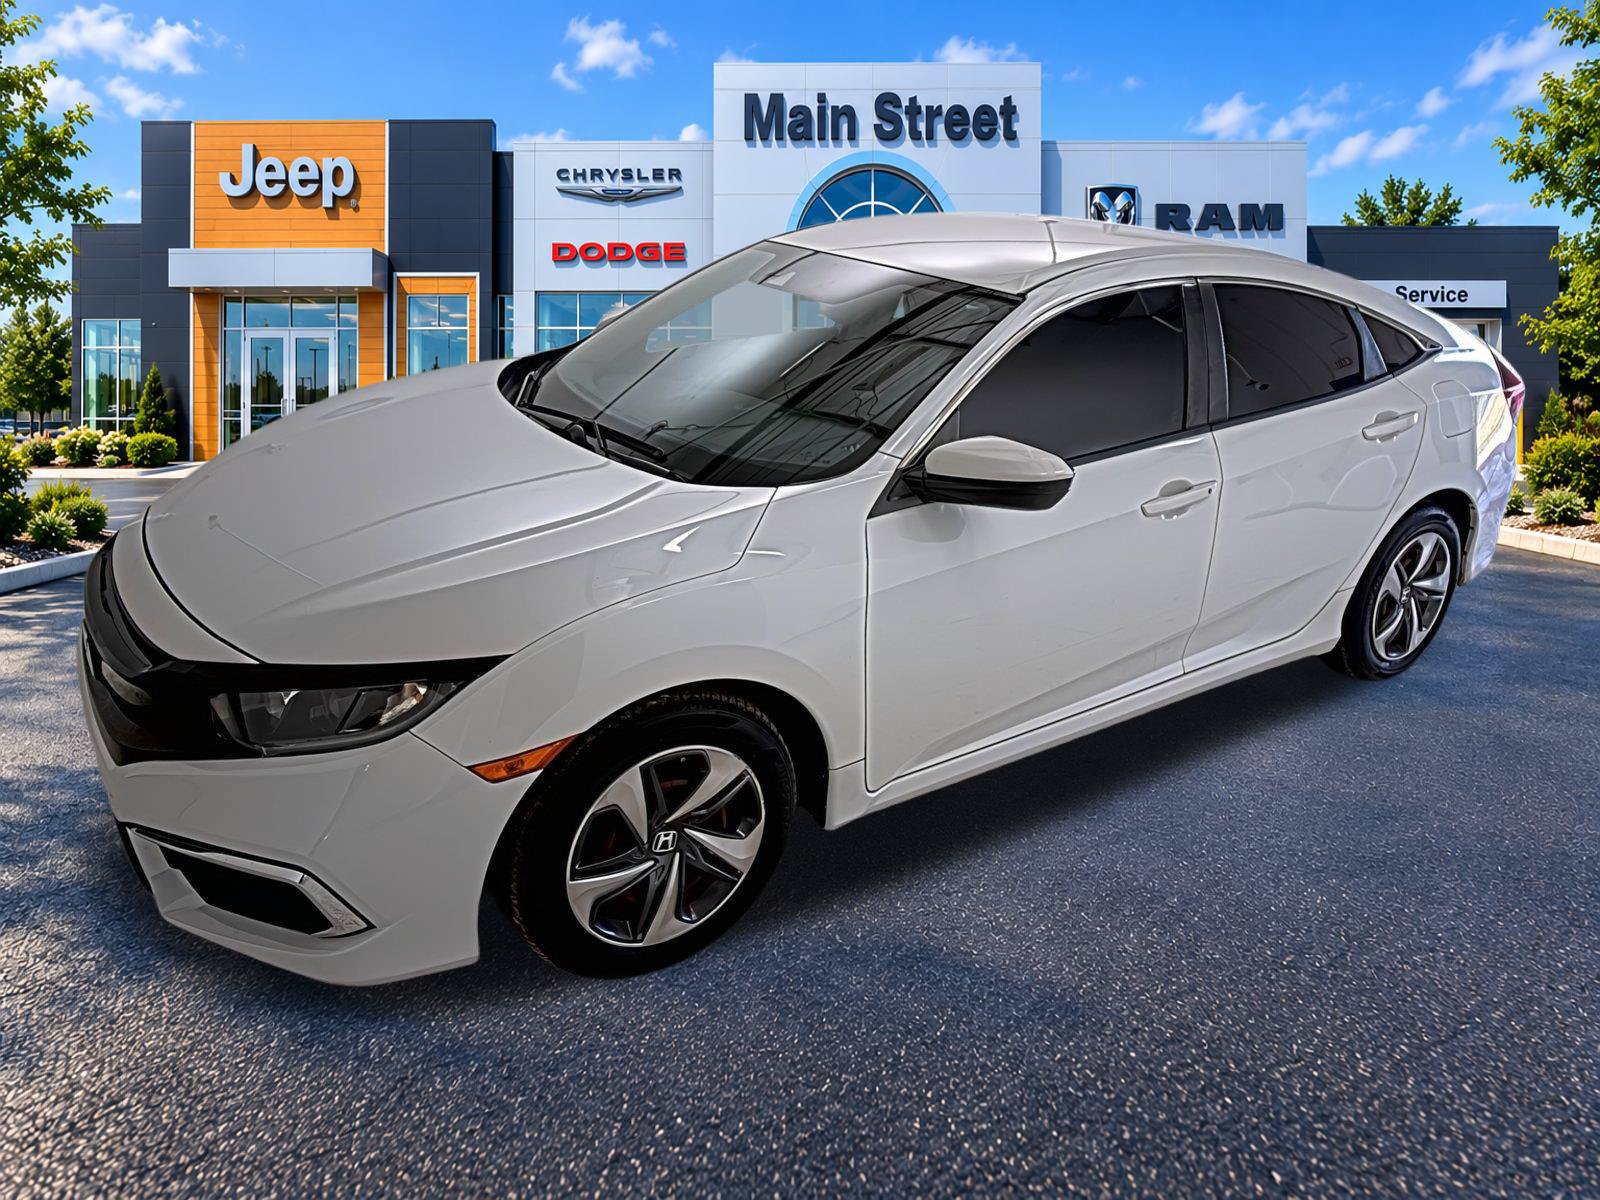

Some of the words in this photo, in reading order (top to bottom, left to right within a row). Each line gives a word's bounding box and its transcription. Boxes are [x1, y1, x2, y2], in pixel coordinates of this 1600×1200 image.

[743, 92, 857, 141] Main
[873, 91, 1018, 141] Street
[219, 143, 356, 209] Jeep
[556, 168, 683, 182] CHRYSLER
[1155, 203, 1285, 232] RAM
[551, 242, 687, 263] DODGE
[1395, 285, 1469, 303] Service
